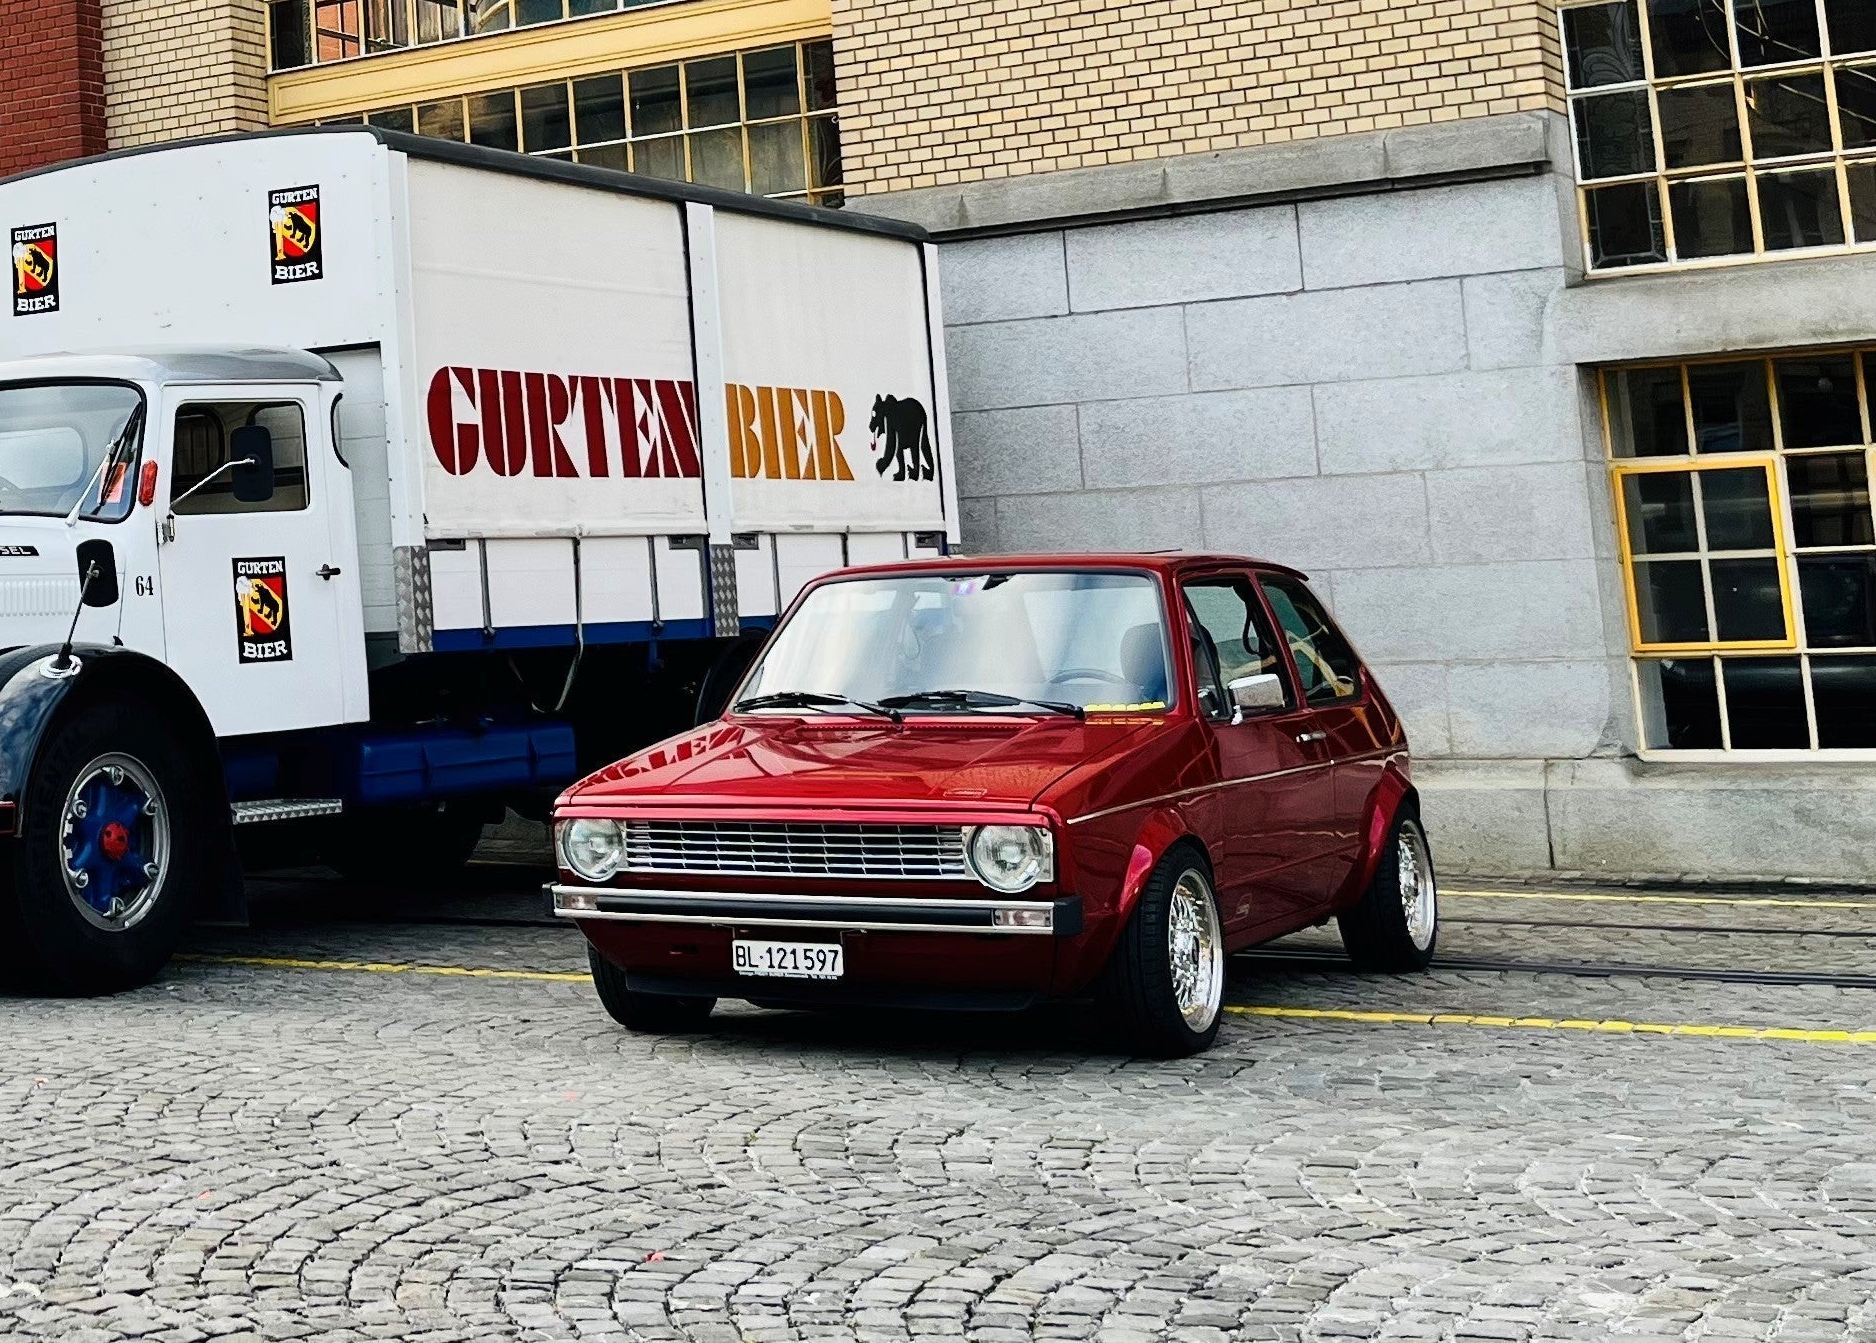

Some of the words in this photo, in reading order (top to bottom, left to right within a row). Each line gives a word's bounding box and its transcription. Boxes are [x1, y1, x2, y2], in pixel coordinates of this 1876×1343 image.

[271, 188, 318, 205] GURTEN
[14, 225, 55, 242] GURTEN
[274, 261, 320, 280] BIER
[16, 294, 57, 312] BIER
[426, 365, 701, 479] GURTEN
[725, 383, 856, 481] BIER
[237, 560, 284, 575] GURTEN
[135, 575, 154, 597] 64
[242, 639, 288, 659] BIER
